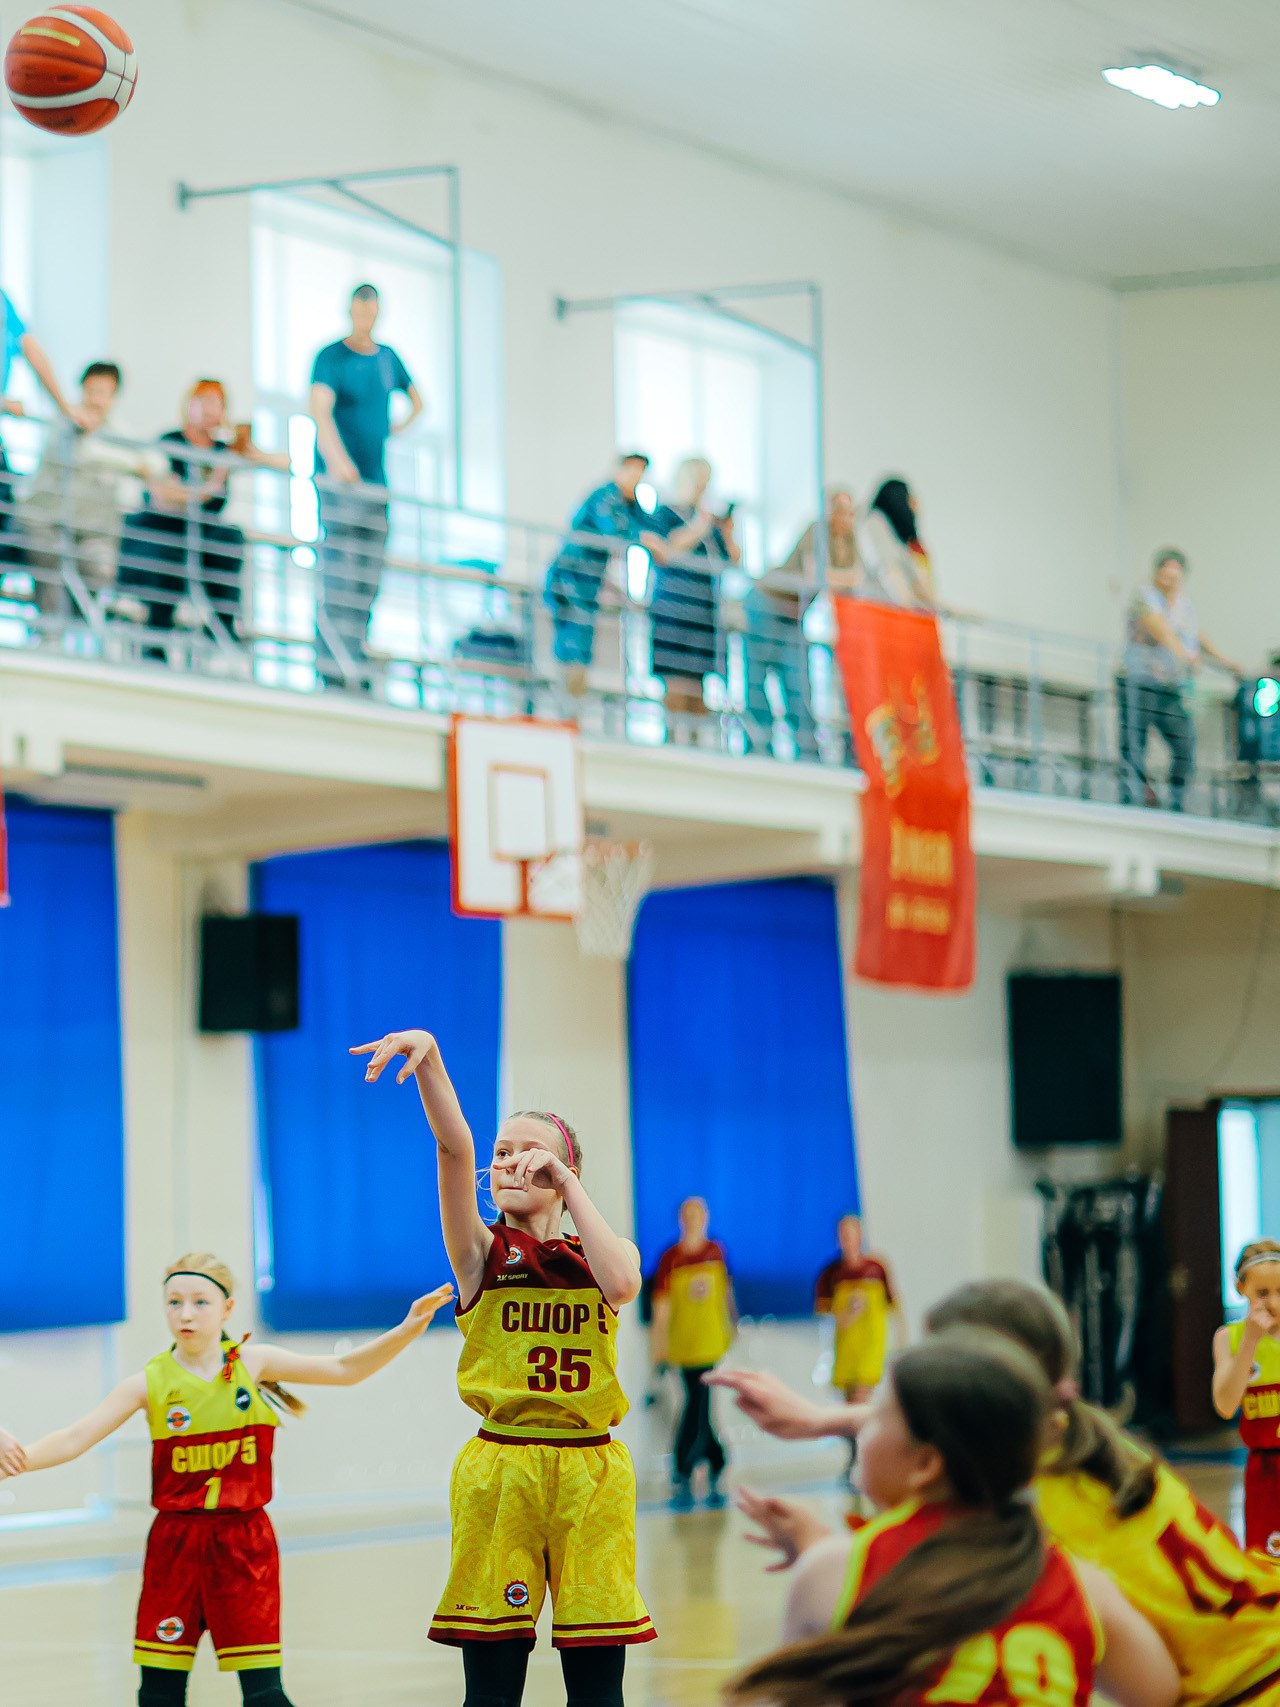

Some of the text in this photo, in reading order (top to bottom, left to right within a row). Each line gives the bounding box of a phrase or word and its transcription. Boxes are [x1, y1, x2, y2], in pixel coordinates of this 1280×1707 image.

[501, 1301, 590, 1334] СШОР
[527, 1345, 592, 1393] 35
[204, 1476, 222, 1510] 1
